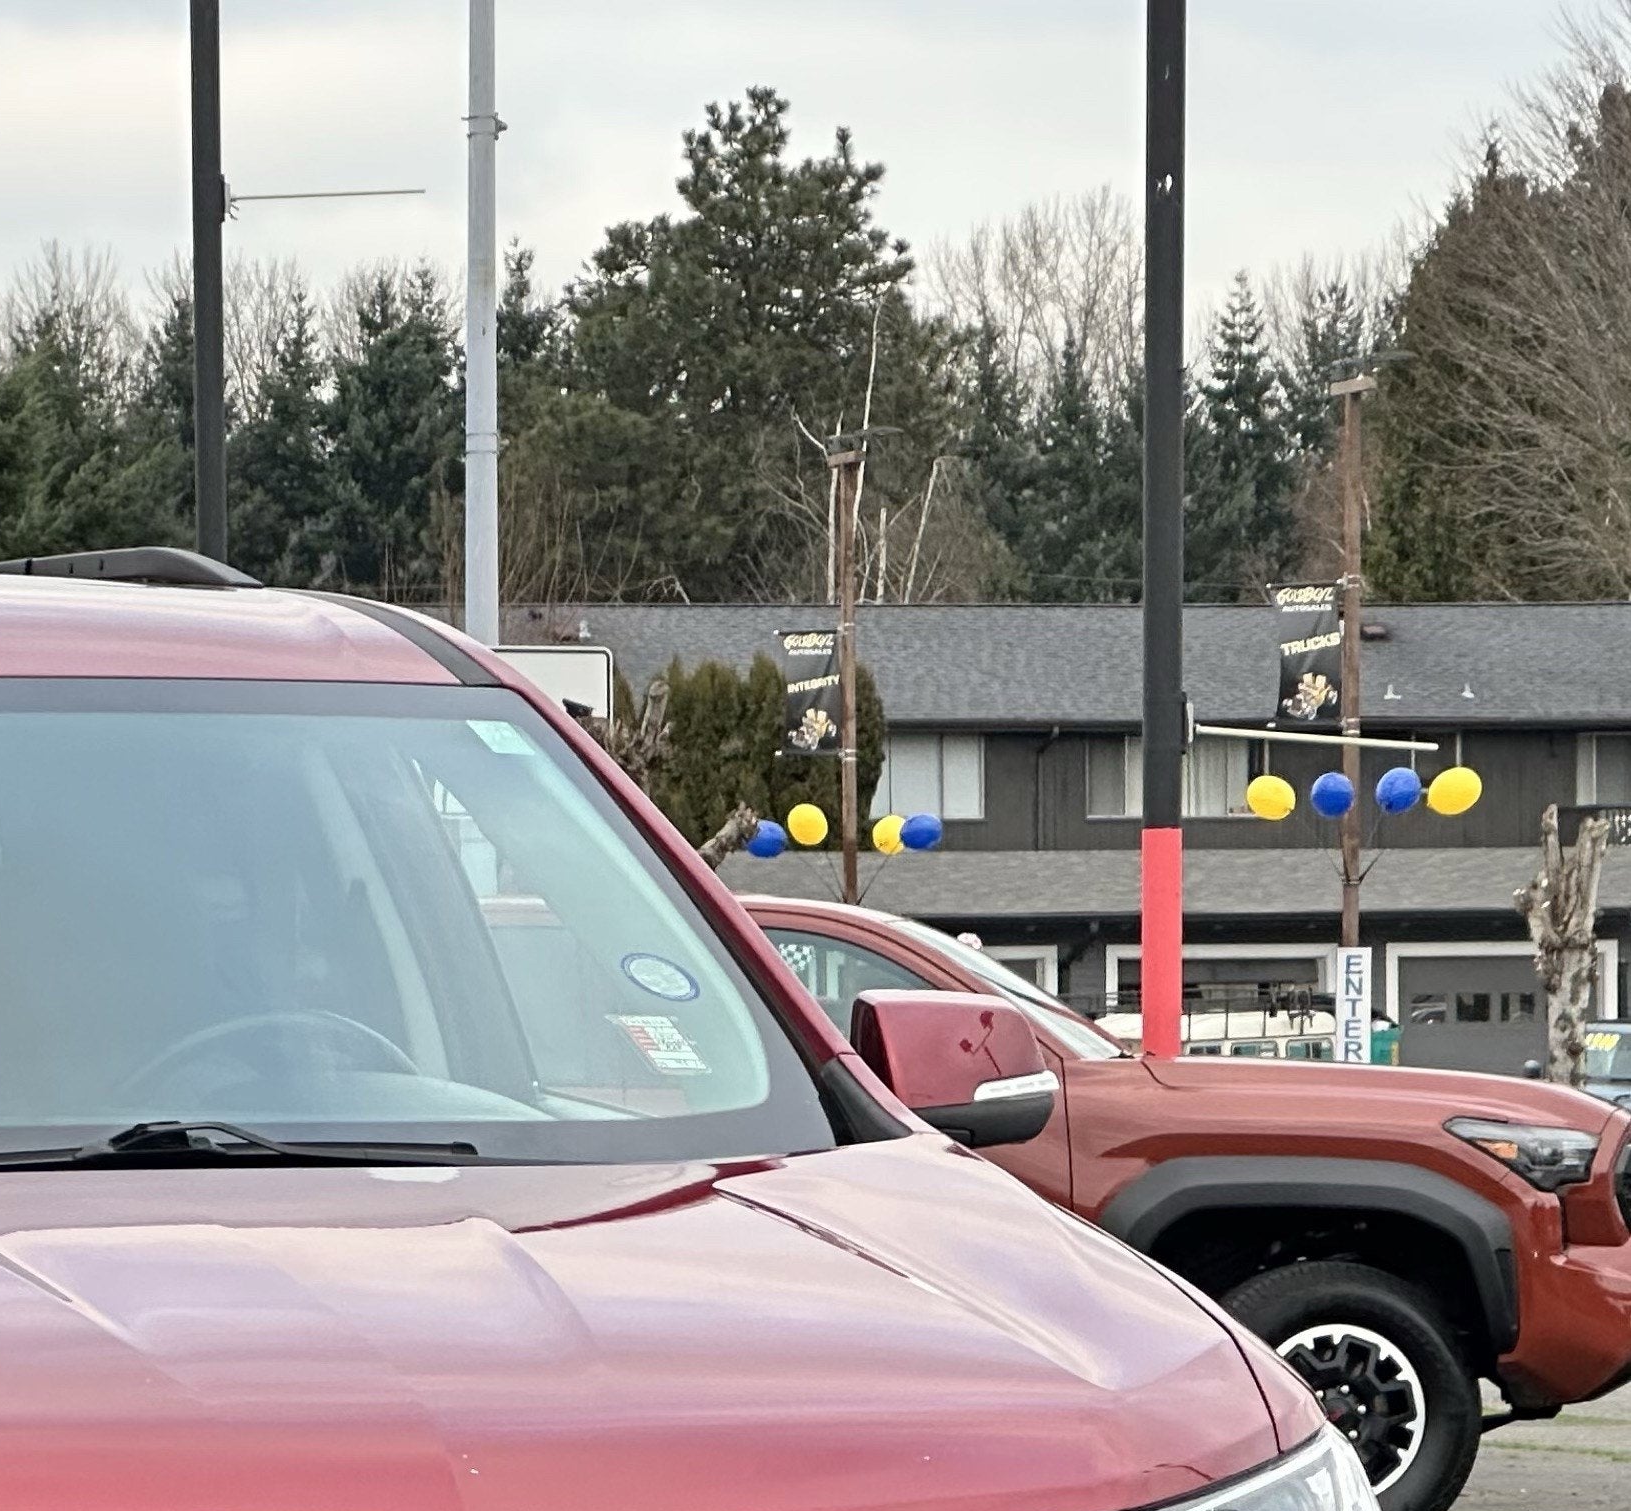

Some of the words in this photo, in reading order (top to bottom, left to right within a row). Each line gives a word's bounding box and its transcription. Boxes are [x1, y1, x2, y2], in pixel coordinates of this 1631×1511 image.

[1280, 632, 1341, 656] TRUCKS
[787, 674, 840, 693] INTEGRITY
[1344, 954, 1364, 1062] ENTER
